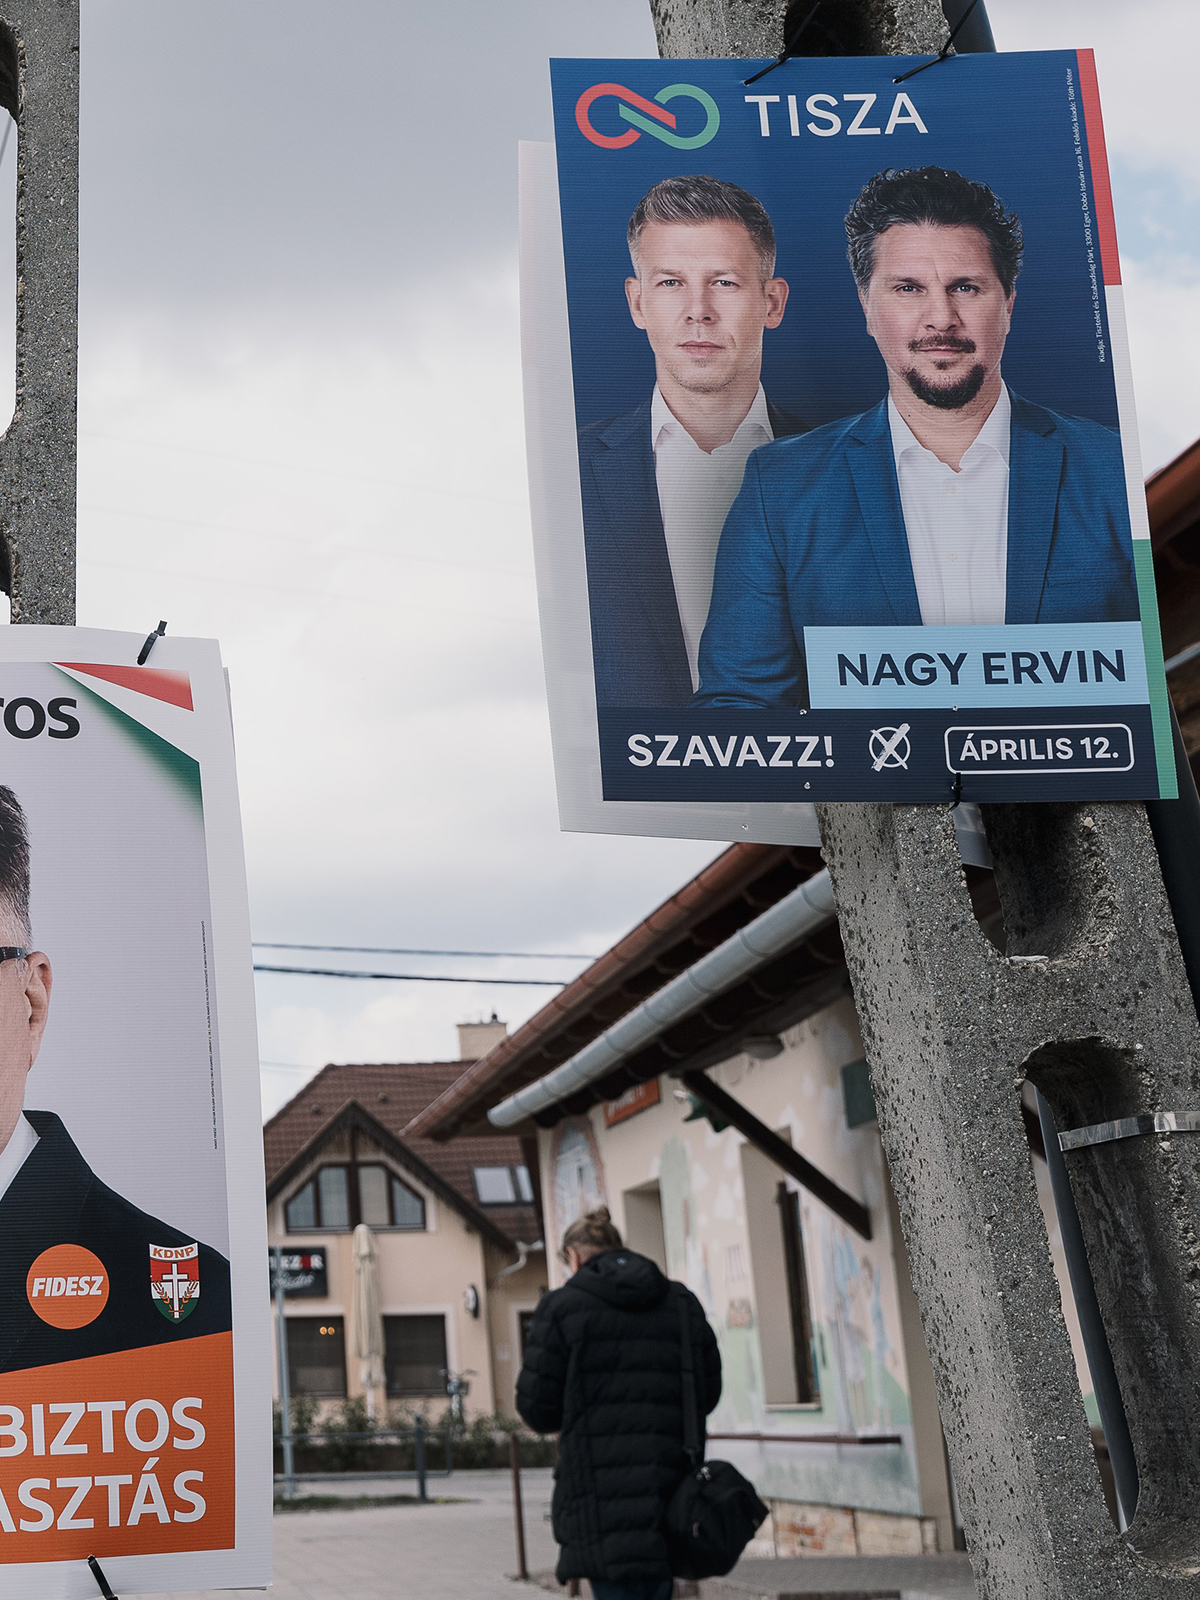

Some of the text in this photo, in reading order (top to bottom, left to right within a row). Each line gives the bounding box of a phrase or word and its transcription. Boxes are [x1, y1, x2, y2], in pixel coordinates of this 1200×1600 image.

[744, 92, 929, 137] TISZA
[1070, 101, 1078, 122] kiadó:
[1085, 228, 1093, 246] 3300
[1090, 263, 1098, 300] Szabadság
[1093, 300, 1100, 310] és
[1094, 310, 1102, 338] Tisztelet
[1098, 339, 1106, 362] Kiadja:
[837, 649, 1126, 686] NAGY ERVIN
[628, 733, 835, 768] SZAVAZZ!
[960, 733, 1119, 761] ÁPRILIS 12.
[152, 1246, 195, 1259] KDNP
[31, 1276, 104, 1298] FIDESZ
